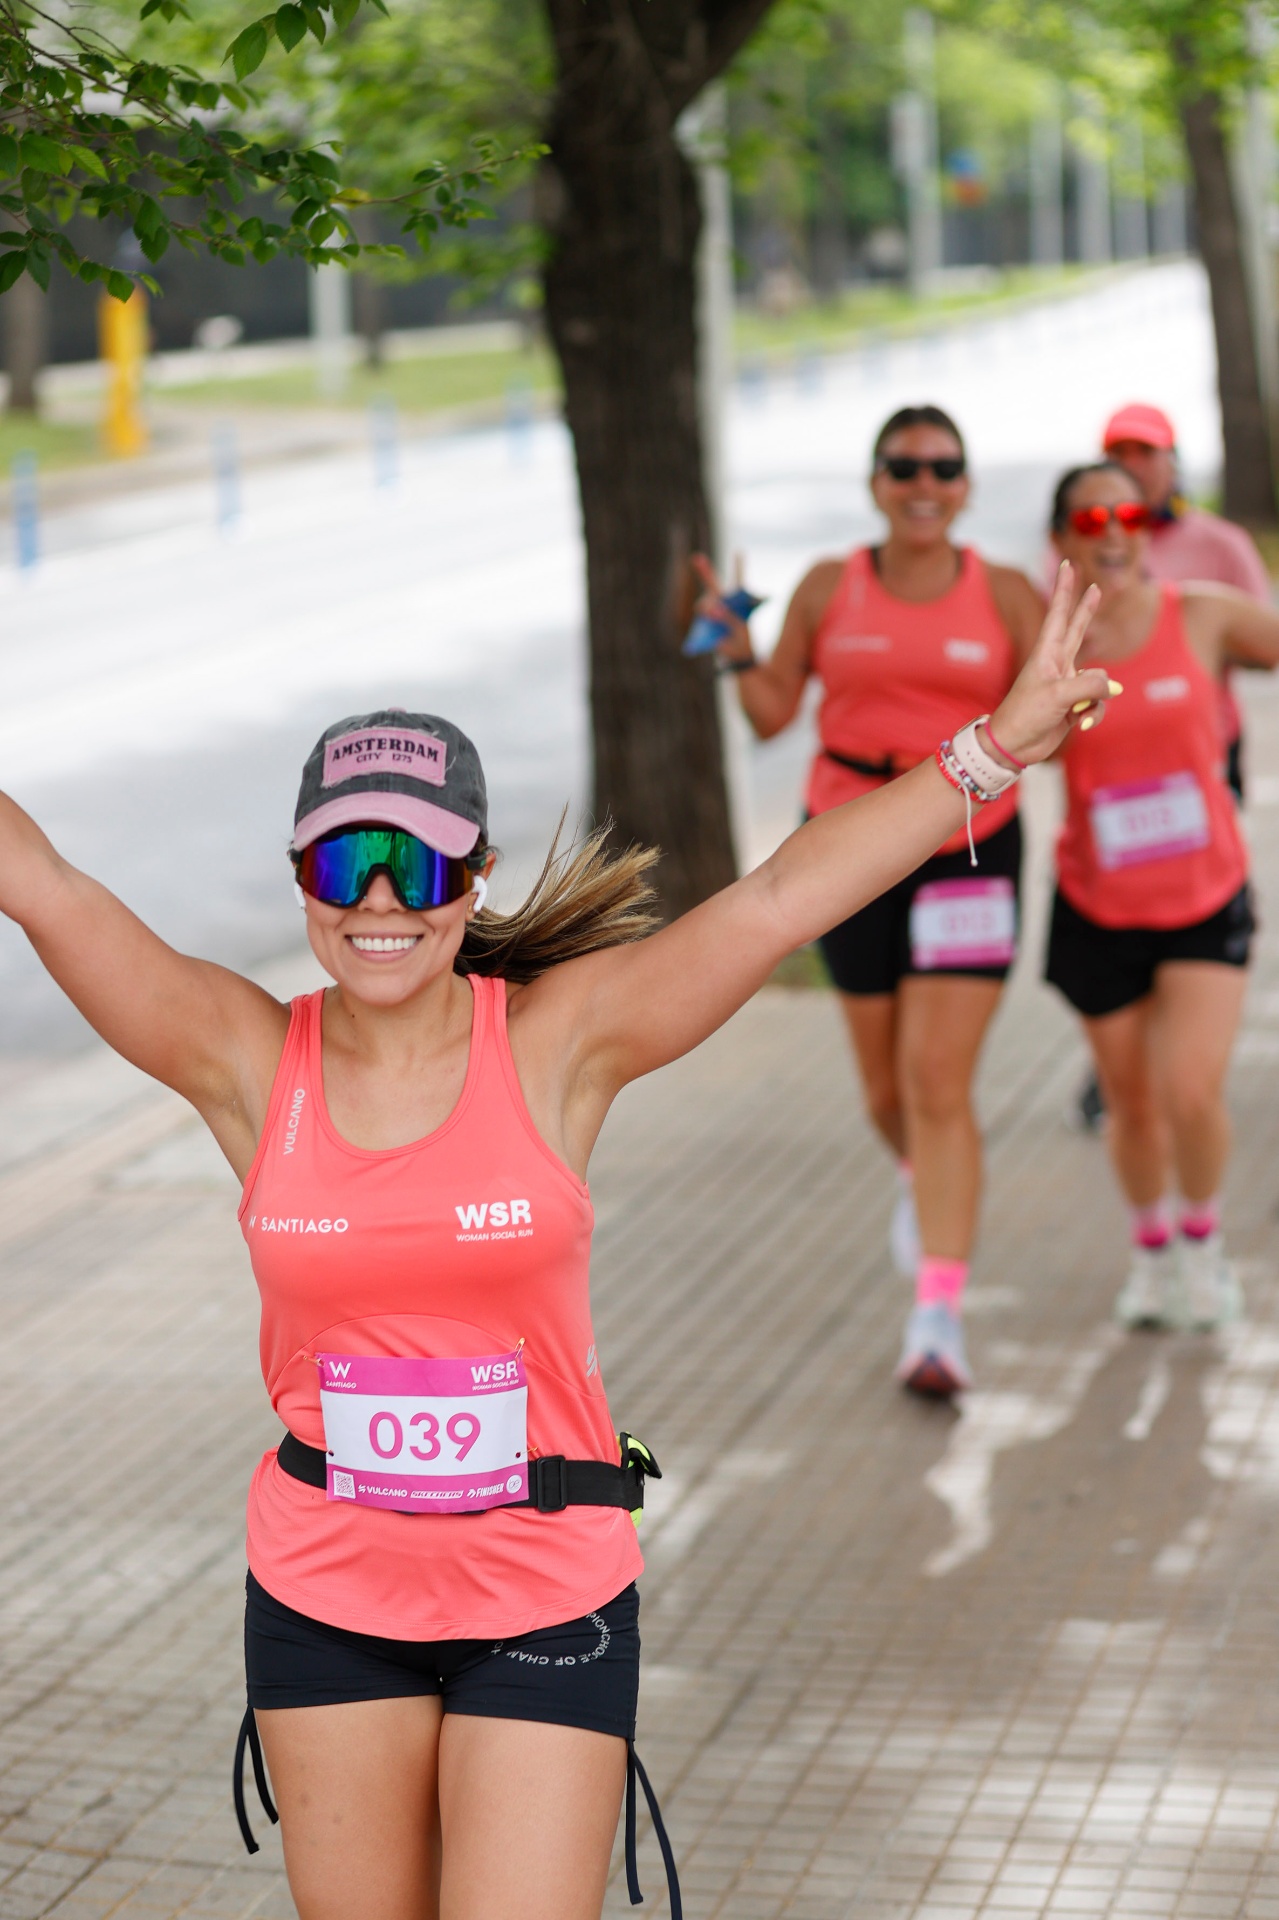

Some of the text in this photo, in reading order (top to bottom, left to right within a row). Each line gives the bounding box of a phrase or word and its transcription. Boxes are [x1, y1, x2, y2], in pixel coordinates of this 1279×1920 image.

[332, 738, 439, 762] AMSTERDAM
[356, 752, 412, 763] CITY 1275
[283, 1088, 306, 1155] VULCANO
[454, 1199, 532, 1230] WSR
[261, 1216, 349, 1234] SANTIAGO
[456, 1228, 534, 1242] WOMAN SOCIAL RUN
[329, 1361, 351, 1379] W
[470, 1360, 519, 1384] WSR
[326, 1380, 357, 1389] SANTIAGO
[368, 1411, 482, 1462] 039
[366, 1485, 408, 1498] VULCANO
[554, 1656, 576, 1666] OF
